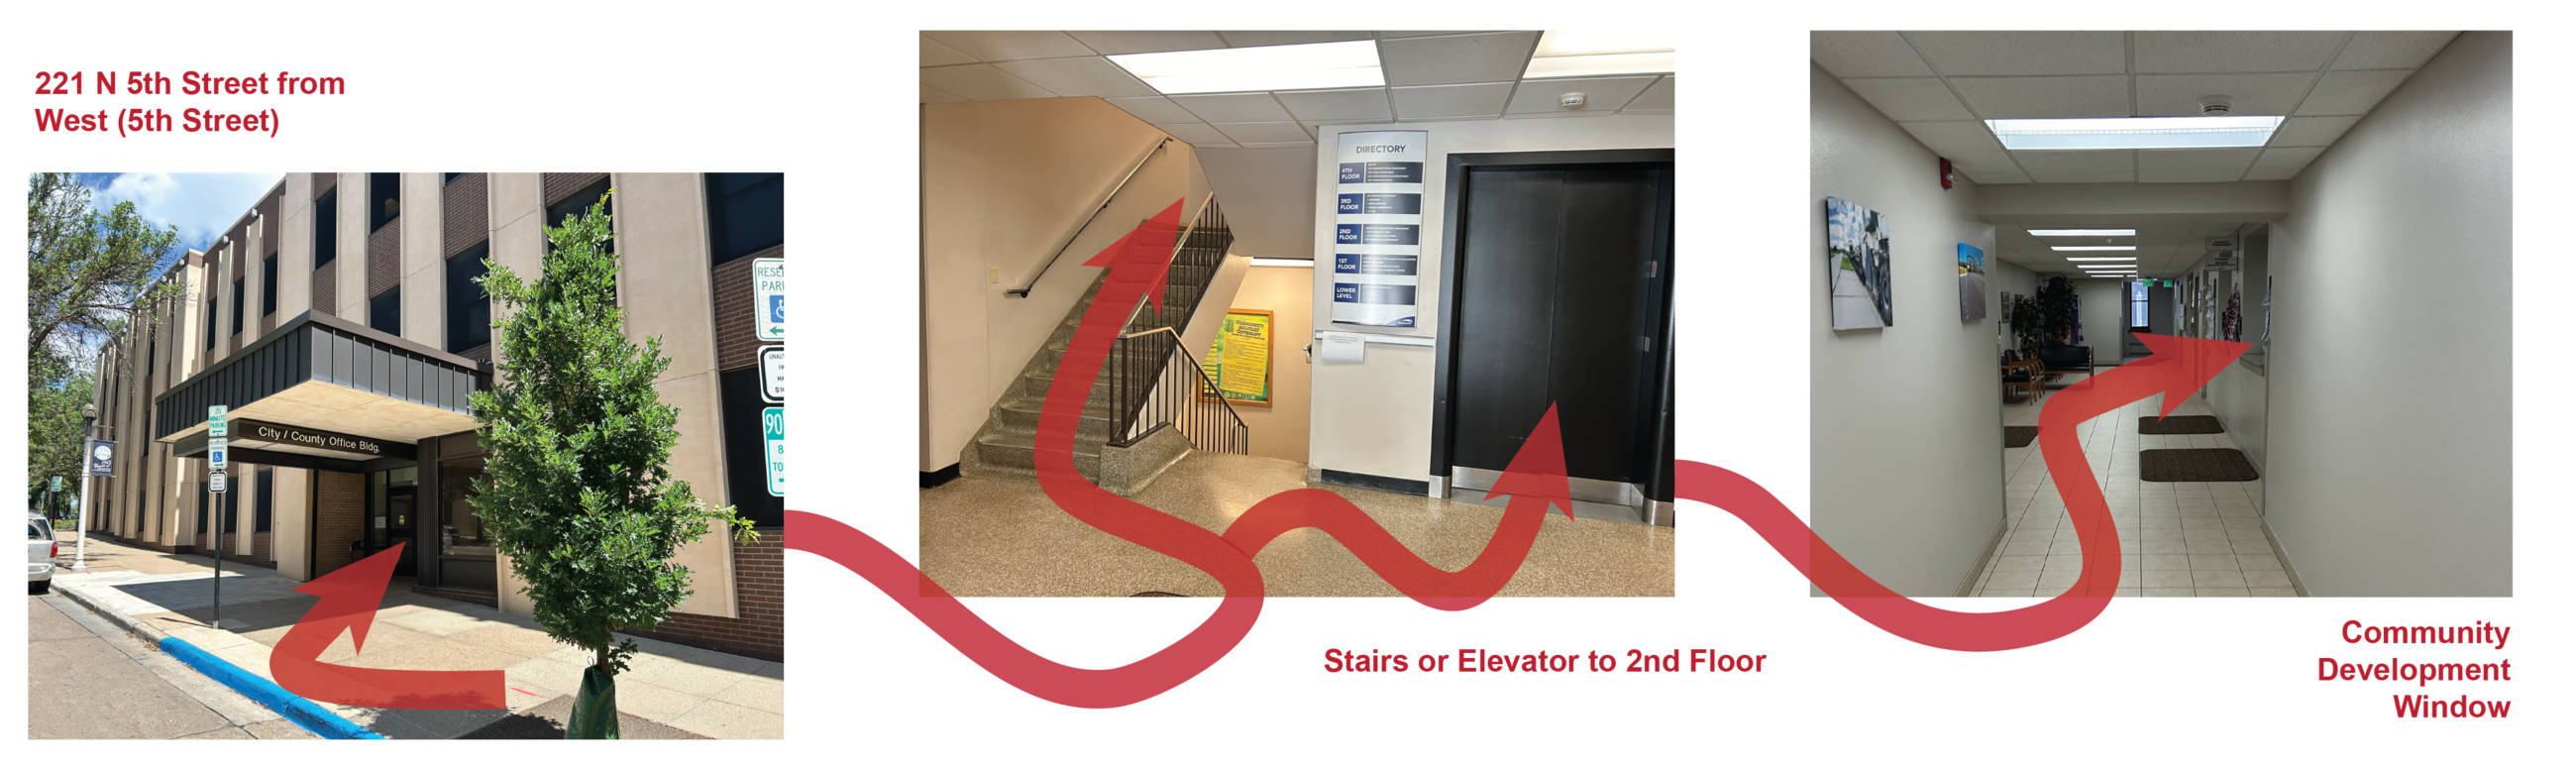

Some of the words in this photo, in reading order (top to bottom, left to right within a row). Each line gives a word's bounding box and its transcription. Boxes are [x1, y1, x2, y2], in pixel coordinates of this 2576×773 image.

[1356, 145, 1406, 154] DIRECTORY
[762, 280, 784, 290] PAR
[766, 413, 783, 435] 90
[259, 426, 280, 441] City
[291, 431, 326, 446] County
[329, 437, 357, 449] Office
[359, 440, 380, 453] Bldg.
